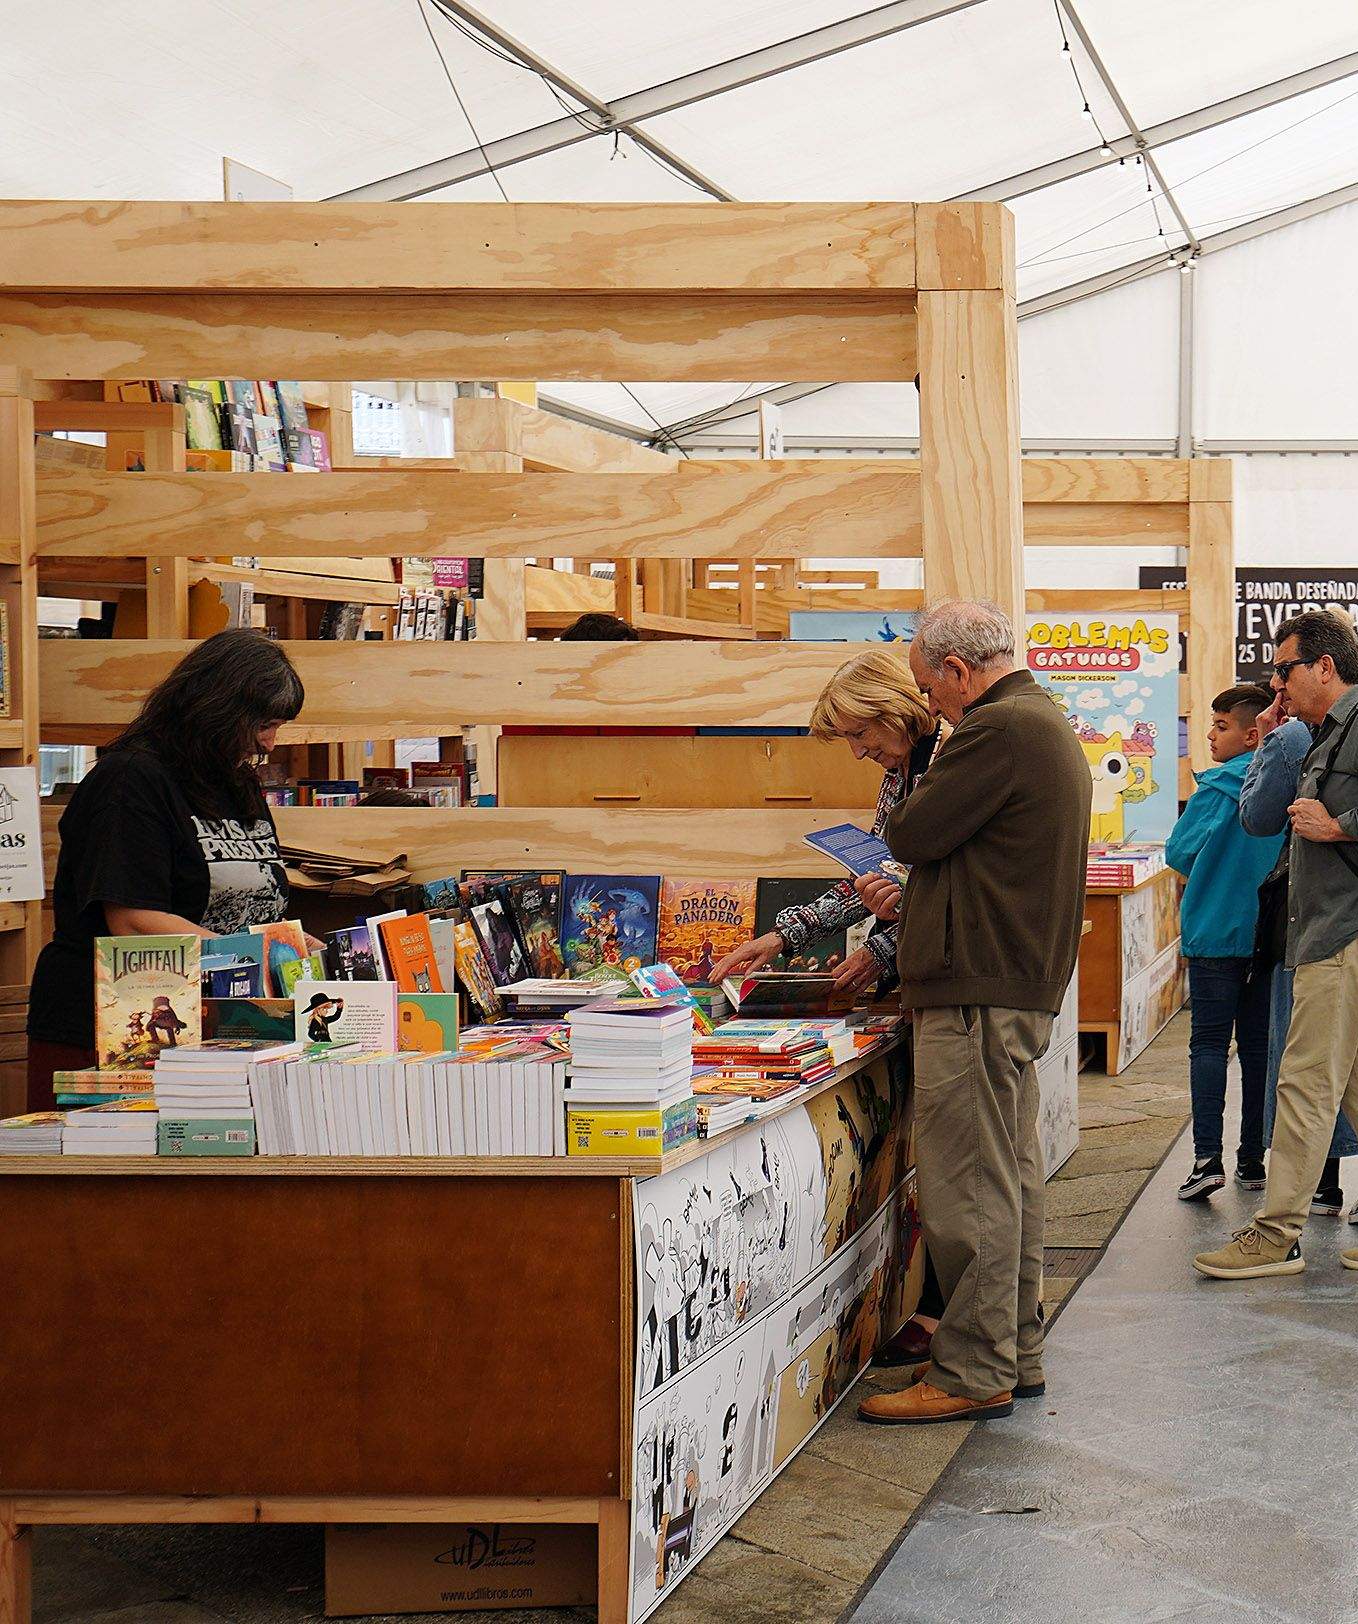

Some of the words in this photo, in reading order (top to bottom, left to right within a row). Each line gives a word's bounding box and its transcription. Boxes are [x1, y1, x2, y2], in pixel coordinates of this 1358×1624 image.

[1246, 581, 1293, 600] BANDA
[1034, 651, 1132, 668] GATUNOS
[1238, 643, 1257, 664] 25
[705, 888, 716, 896] EL
[680, 896, 739, 912] DRAGÓN
[674, 910, 743, 926] PANADERO
[112, 945, 190, 983] LIGHTFALL
